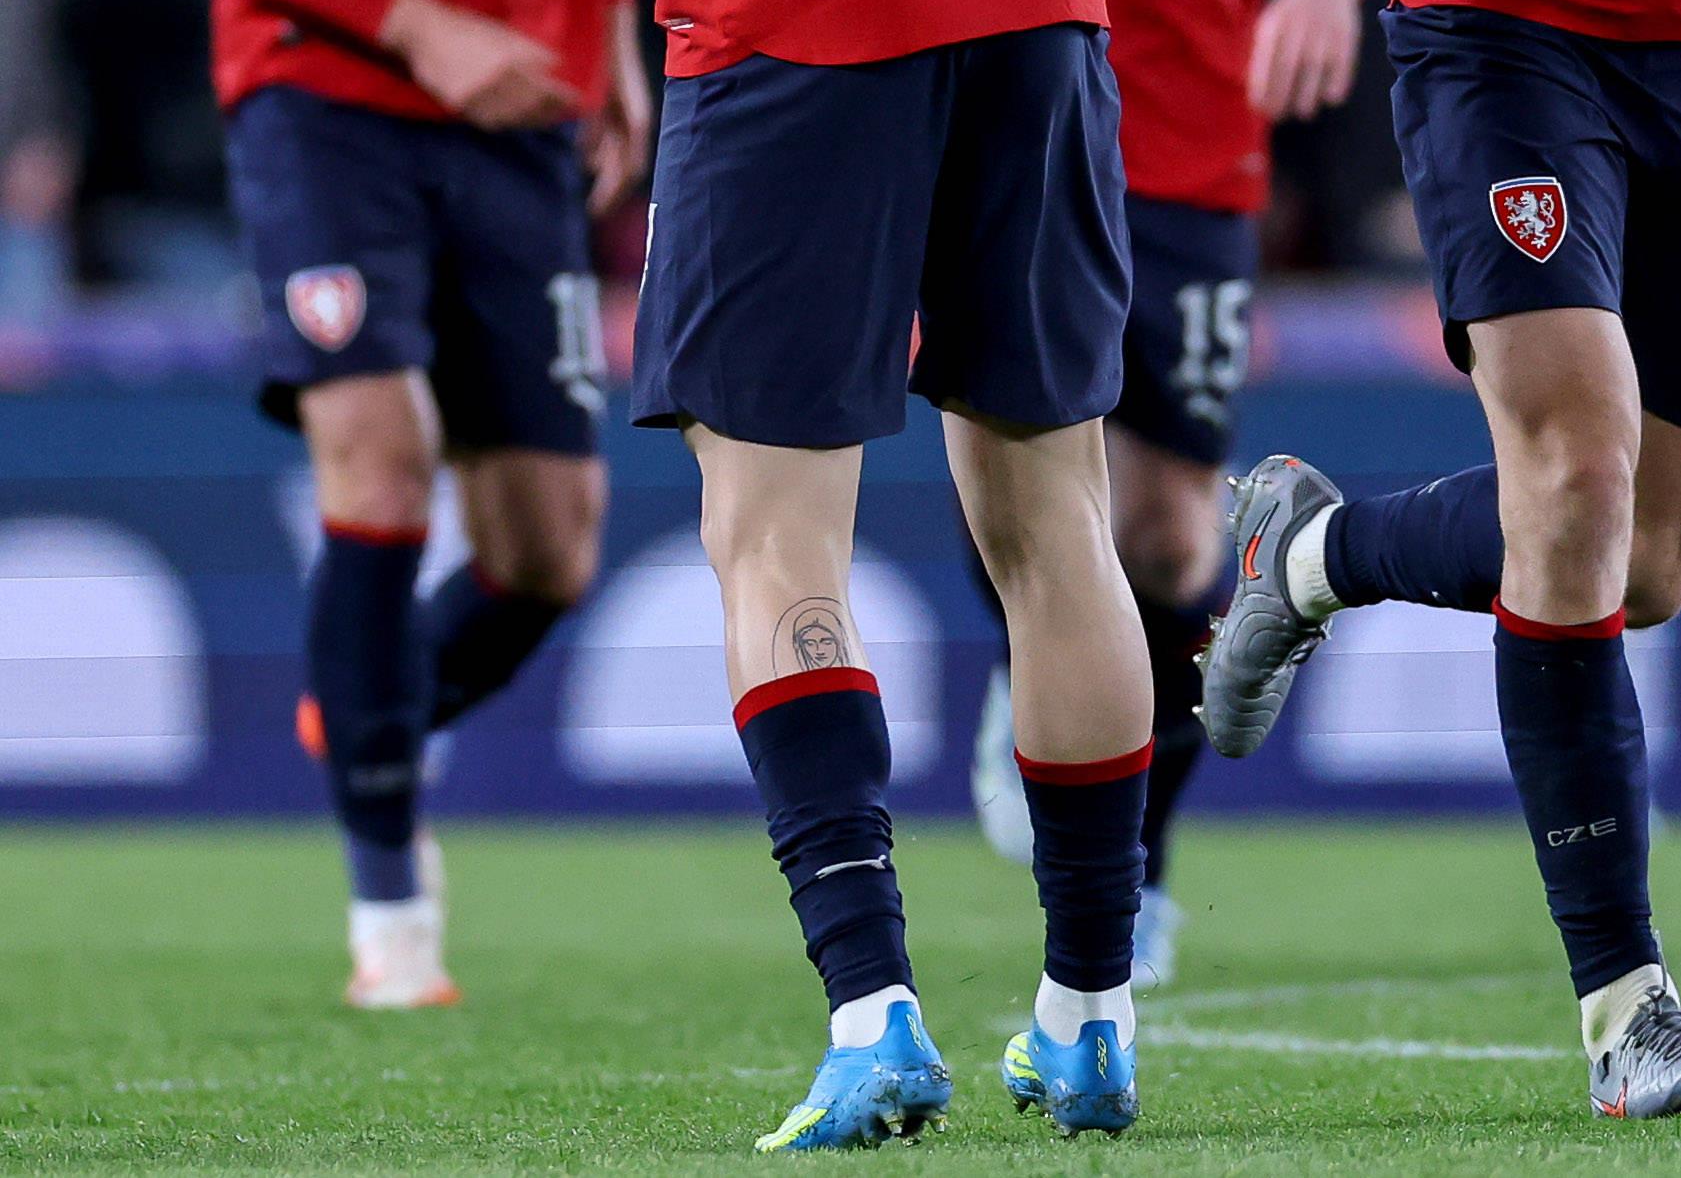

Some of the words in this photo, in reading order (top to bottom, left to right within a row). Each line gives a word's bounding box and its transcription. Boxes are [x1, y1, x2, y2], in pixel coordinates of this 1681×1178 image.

[1170, 278, 1252, 390] 15
[1546, 817, 1617, 848] CZE
[1097, 1036, 1108, 1081] F50
